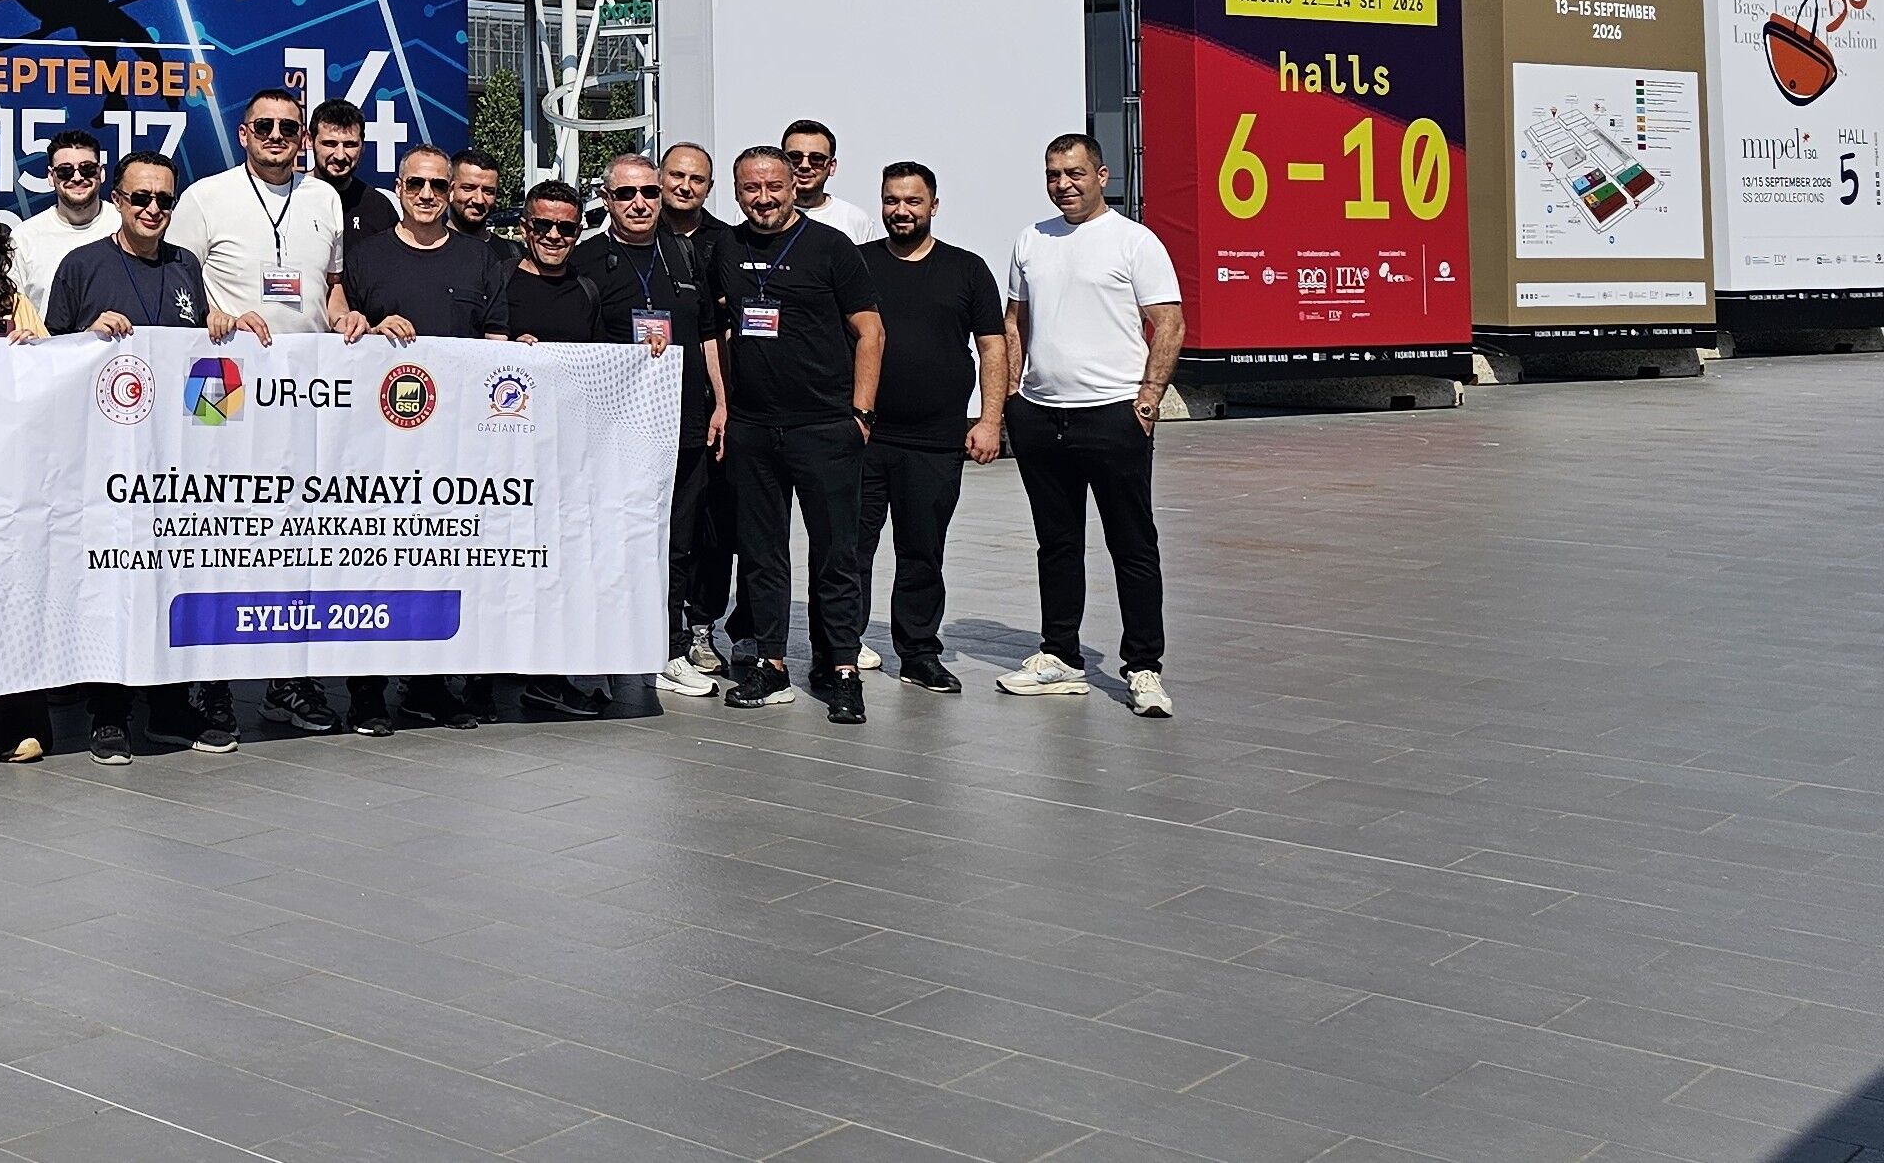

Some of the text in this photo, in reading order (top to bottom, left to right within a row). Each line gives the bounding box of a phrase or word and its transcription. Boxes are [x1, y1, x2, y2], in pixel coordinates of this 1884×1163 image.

[1593, 2, 1656, 20] SEPTEMBER
[1592, 23, 1622, 40] 2026
[1279, 50, 1390, 95] halls
[1741, 127, 1801, 169] mipel
[1838, 128, 1869, 145] HALL
[1742, 176, 1832, 189] 13/15 SEPTEMBER 2026
[1839, 152, 1860, 206] 5
[1742, 192, 1825, 203] SS 2027 COLLECTIONS
[1336, 267, 1365, 286] ITA
[256, 377, 353, 409] UR-GE
[395, 401, 420, 413] GSO
[106, 466, 535, 506] GAZİANTEP SANAYİ ODASI
[152, 512, 481, 537] GAZİANTEP AYAKKABI KÜMESİ
[88, 544, 549, 570] MICAM VE LINEAPELLE 2026 FUARI HEYETİ
[235, 599, 391, 632] EYLÜL 2026
